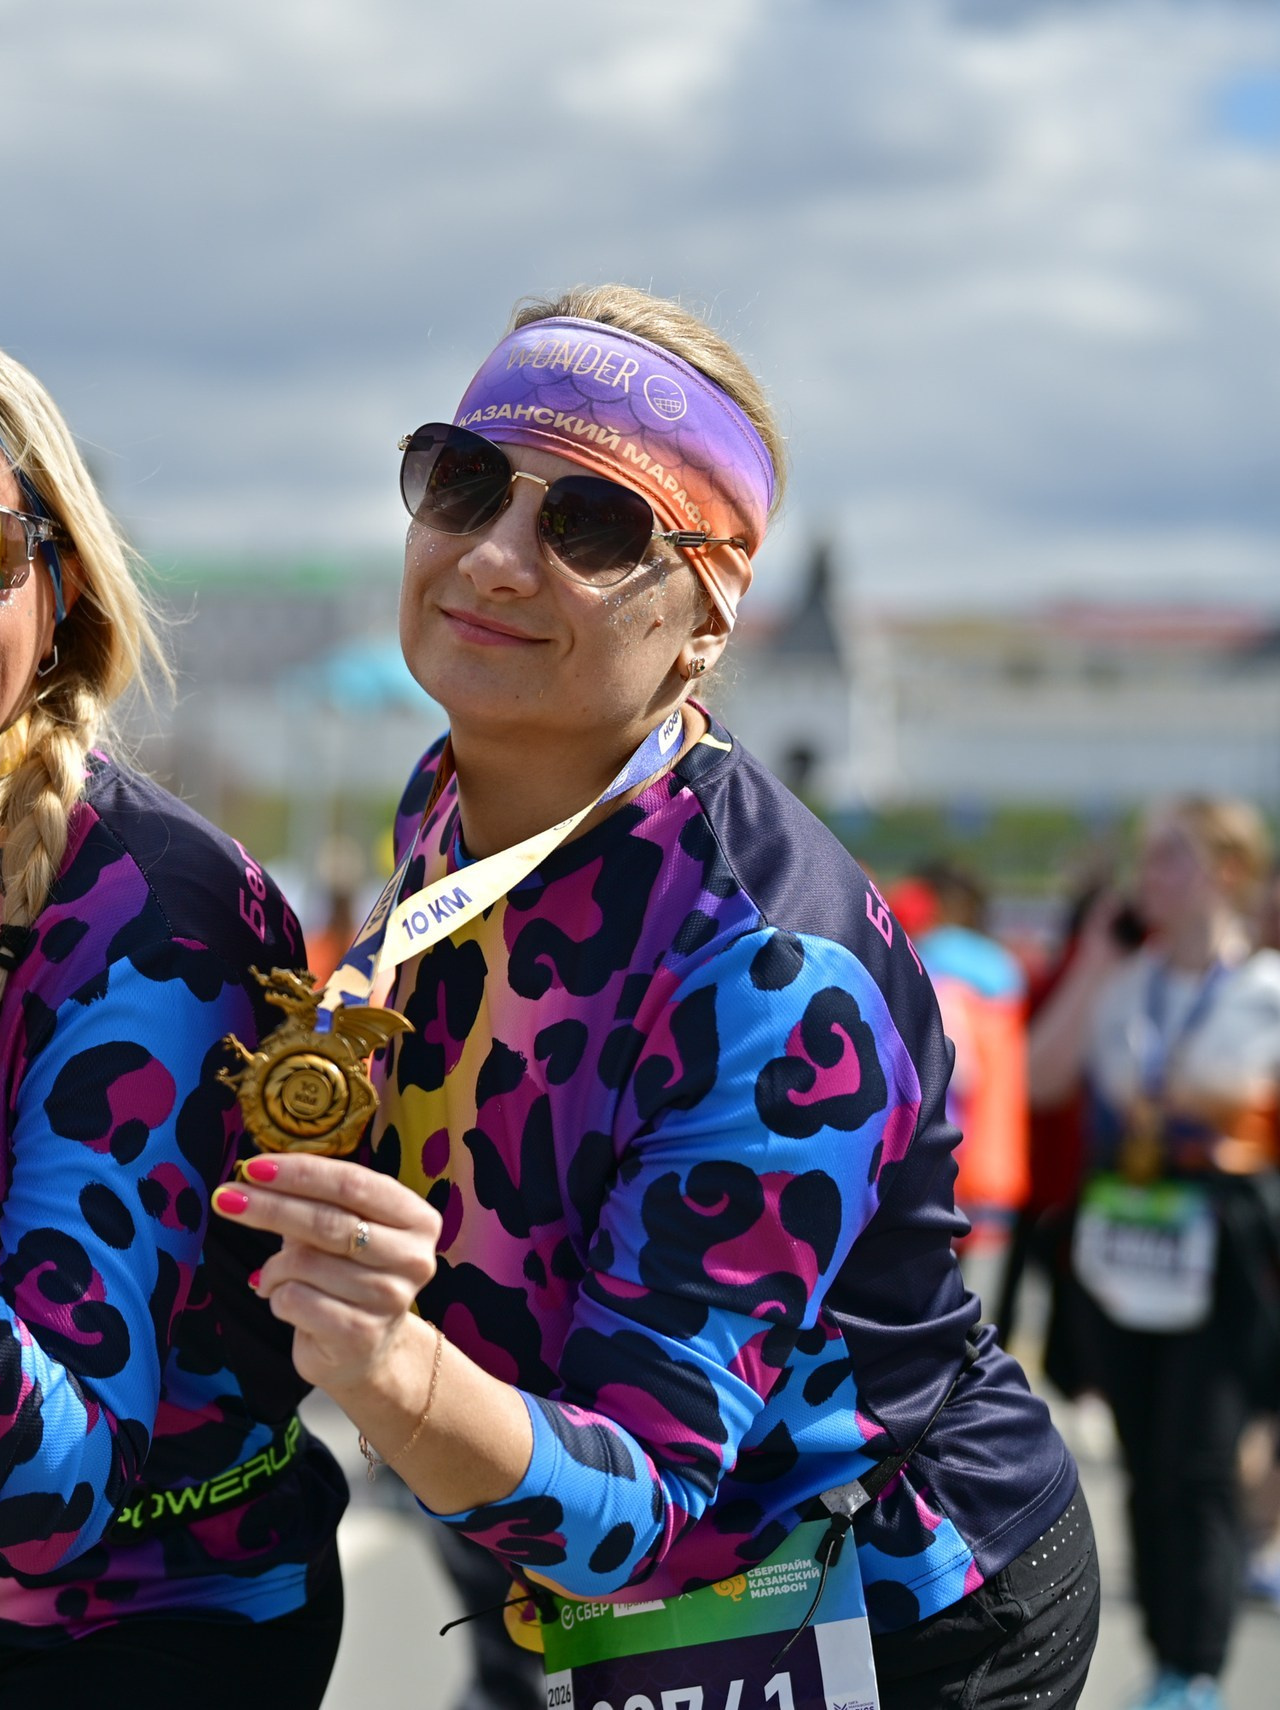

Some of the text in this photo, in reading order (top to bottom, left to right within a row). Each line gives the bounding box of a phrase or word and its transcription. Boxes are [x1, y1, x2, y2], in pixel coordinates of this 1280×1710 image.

[506, 339, 639, 393] WONDER
[458, 404, 719, 552] КАЗАНСКИЙ МАРАФО
[402, 911, 429, 940] 10
[427, 886, 473, 924] KM
[746, 1559, 813, 1578] СБЕРПРАЙМ
[748, 1567, 821, 1589] КАЗАНСКИЙ
[750, 1582, 808, 1599] МАРАФОН
[576, 1602, 610, 1622] СБЕР
[548, 1684, 572, 1708] 2026
